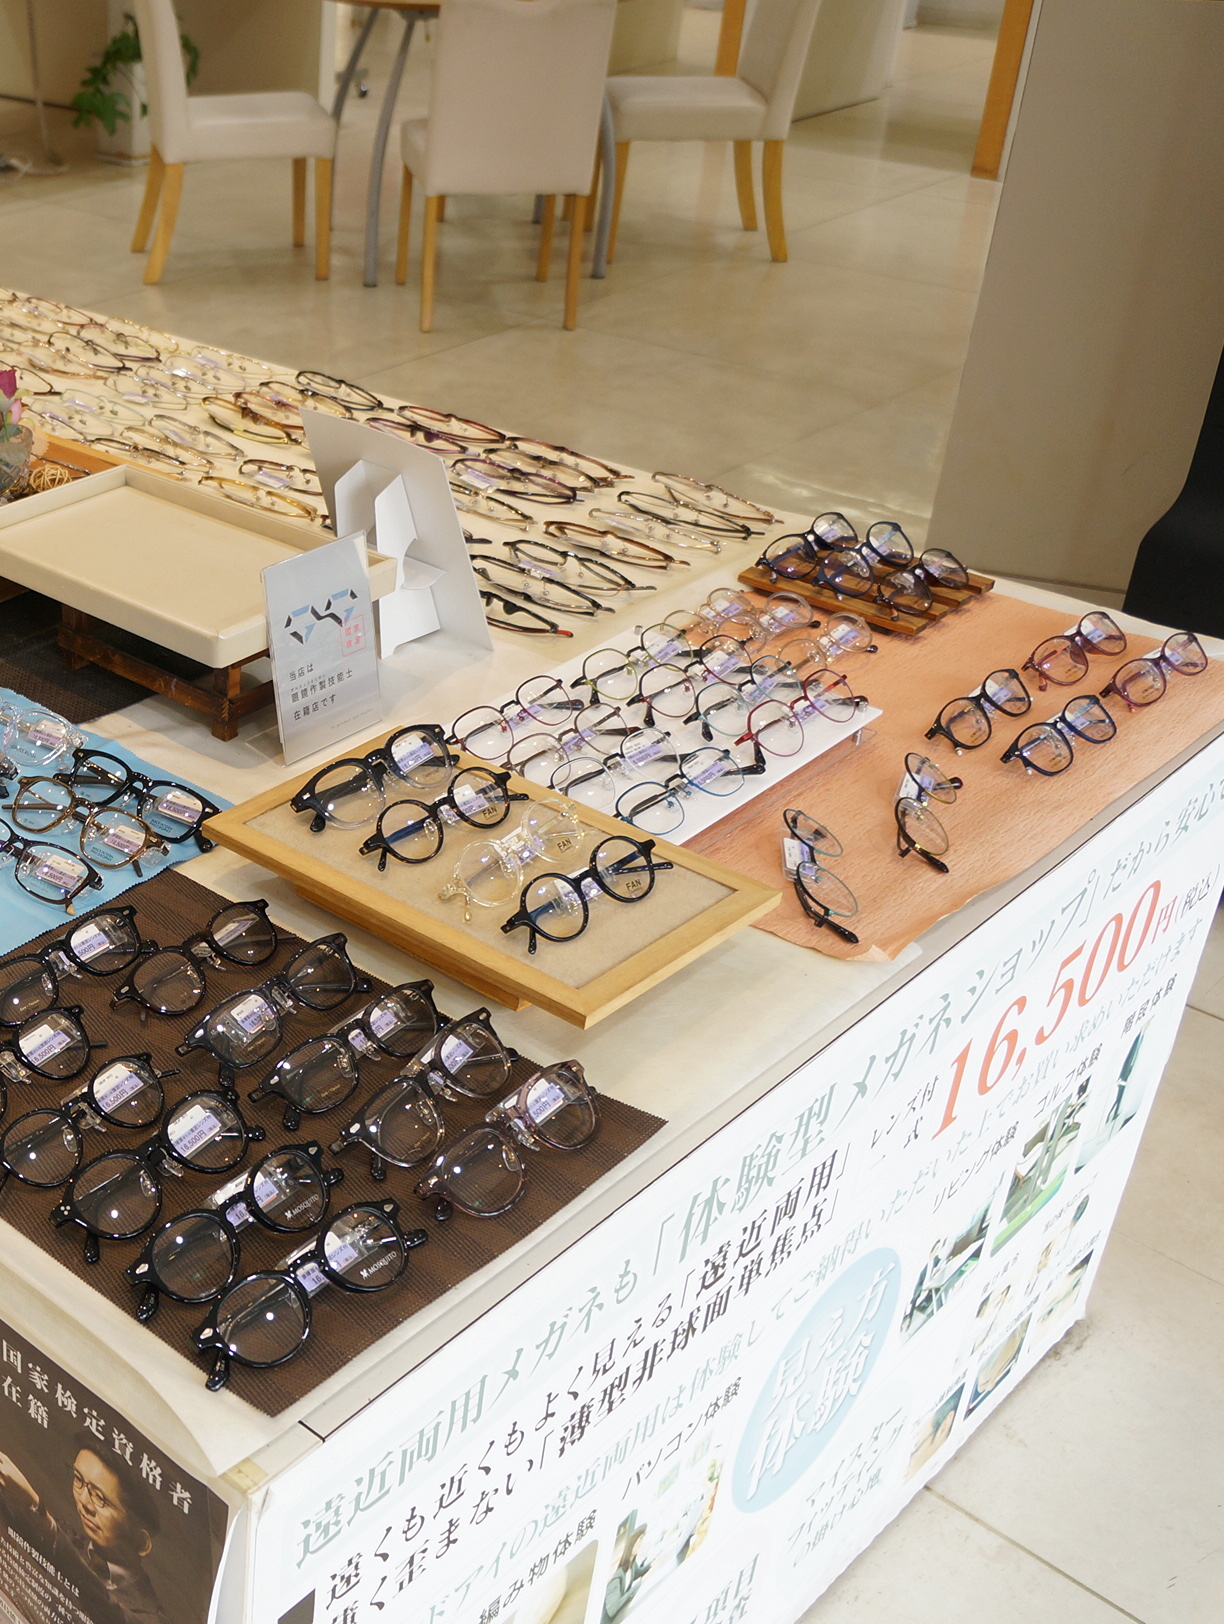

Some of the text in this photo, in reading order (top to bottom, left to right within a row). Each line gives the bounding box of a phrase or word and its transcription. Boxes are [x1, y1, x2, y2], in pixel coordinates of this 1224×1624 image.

[288, 662, 315, 683] 当店は
[291, 668, 354, 704] 眼鏡作製技能士
[293, 693, 338, 722] 在籍店です
[482, 805, 499, 819] FAN
[557, 837, 573, 852] FAN
[626, 877, 643, 892] FAN
[1120, 973, 1178, 1039] 階段体験
[870, 1075, 940, 1149] レンズ付
[1032, 1042, 1103, 1119] ゴルフ体験
[179, 1128, 208, 1155] 16,500円
[295, 778, 1224, 1570] 遠近両用メガネも「体験型メガネショップ」だから安心
[931, 1120, 1020, 1214] リビング体験
[291, 1193, 320, 1217] MOSQUITO
[367, 1250, 398, 1277] MOSQUITO
[773, 1262, 896, 1402] 見え方
[621, 1376, 742, 1502] パソコン体験
[746, 1329, 876, 1501] 体験
[787, 1414, 908, 1546] フィッティング
[805, 1406, 904, 1508] マイスター
